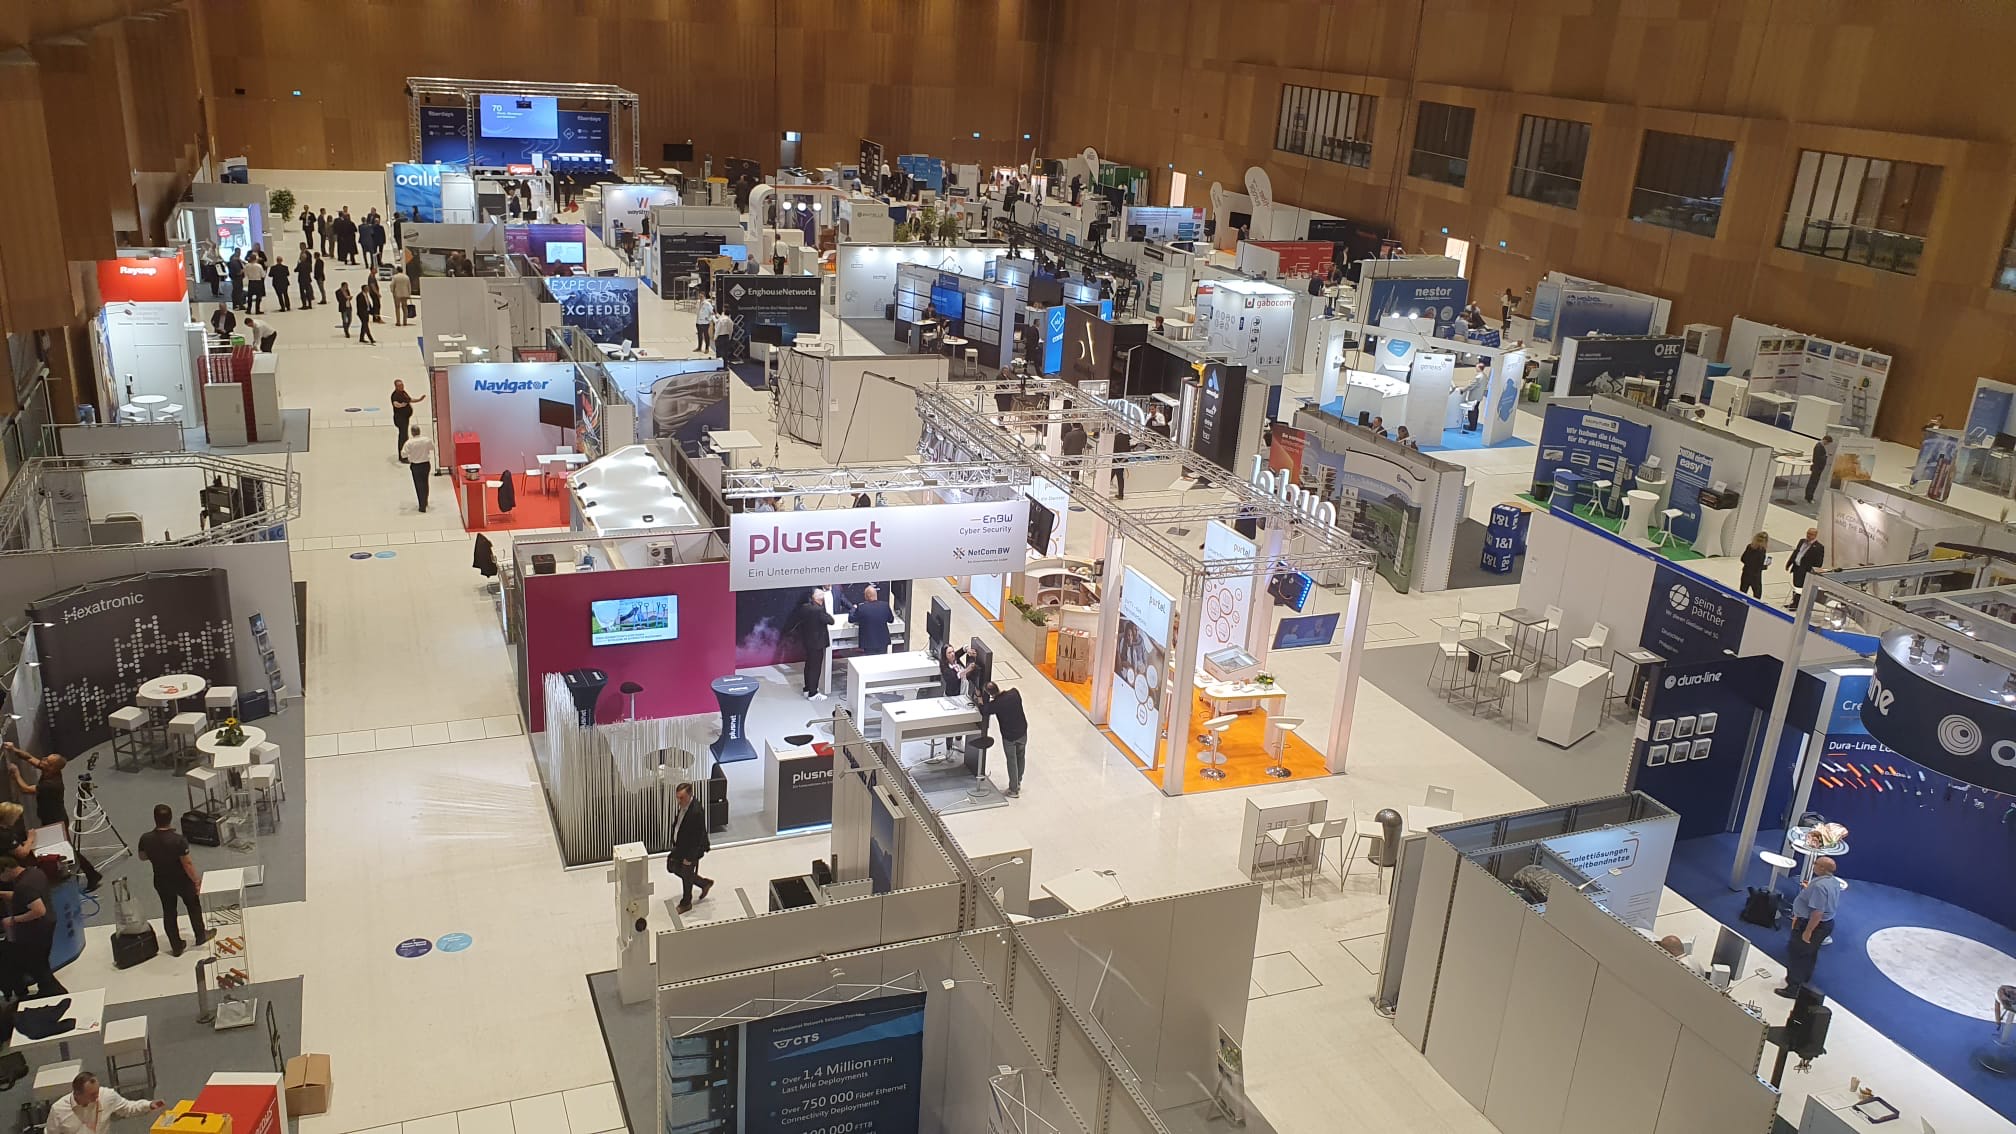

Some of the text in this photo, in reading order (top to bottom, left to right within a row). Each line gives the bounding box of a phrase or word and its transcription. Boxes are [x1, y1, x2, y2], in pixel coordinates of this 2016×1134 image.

[119, 266, 157, 276] Raycap
[1415, 286, 1453, 297] nestor
[1256, 298, 1292, 309] gabocom
[474, 378, 549, 394] Navigator
[983, 514, 1013, 523] EnBW
[960, 526, 1012, 536] Cyber Security
[749, 521, 882, 562] plusnet
[1496, 538, 1513, 549] 1&1
[967, 548, 996, 556] NetCom
[749, 561, 881, 578] Ein Unternehmen der EnBW
[63, 592, 145, 624] Hexatronic
[1694, 596, 1715, 612] seim
[1692, 605, 1725, 627] partner
[1677, 671, 1722, 687] dura-line
[730, 715, 738, 740] plusnet
[1829, 741, 1877, 751] Dura-Line
[793, 1033, 820, 1046] CTS
[782, 1056, 893, 1085] Over 1,4 Million FTTH
[782, 1071, 868, 1094] Last Mile Deployments
[781, 1083, 907, 1116] Over 750 000 Fiber Ethernet
[781, 1099, 880, 1125] Connectivity Deployments
